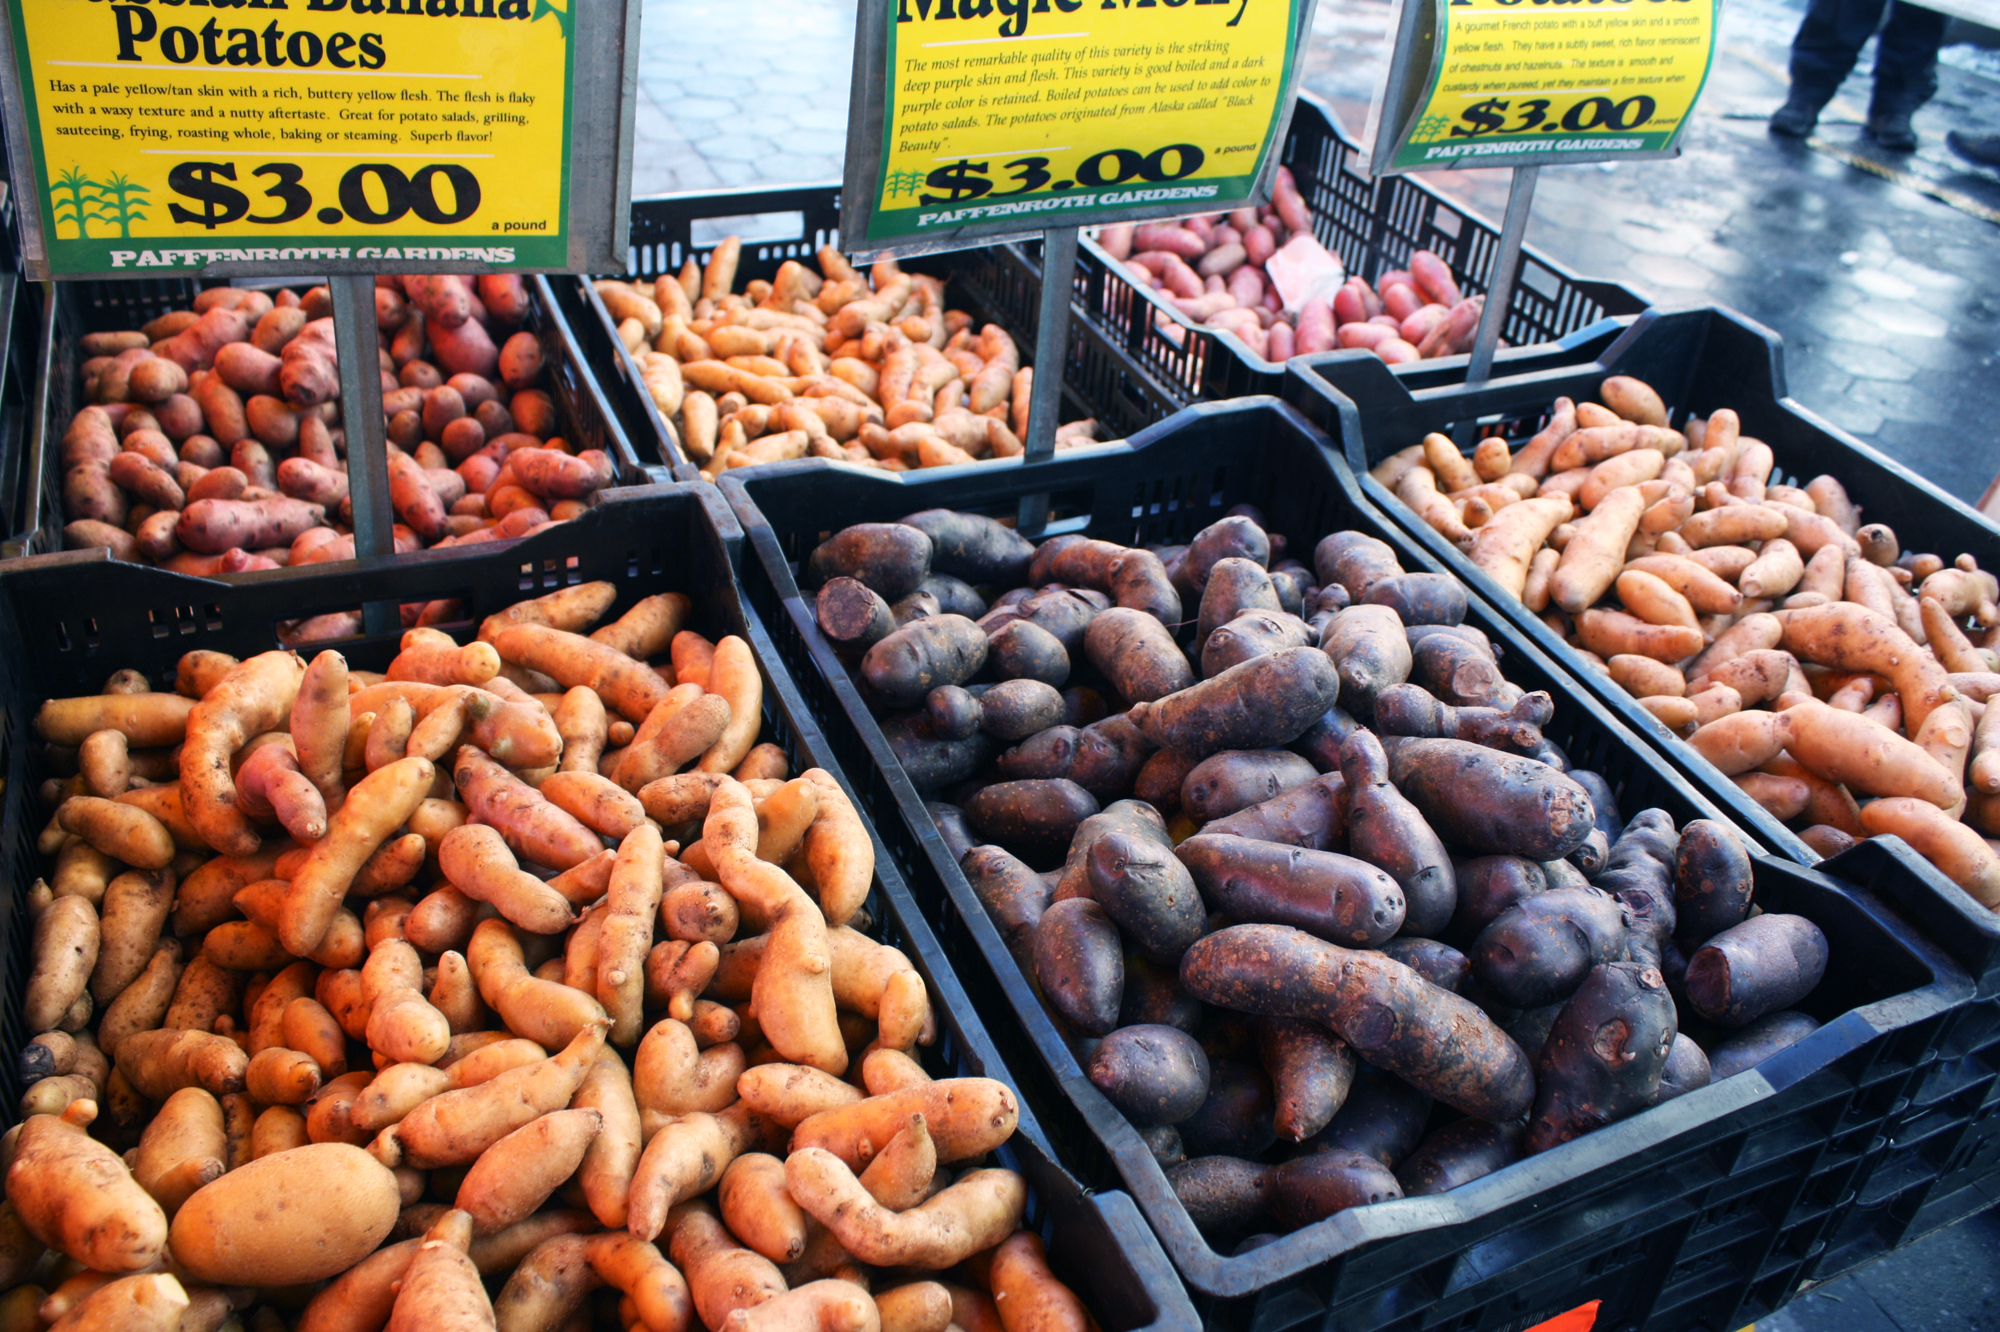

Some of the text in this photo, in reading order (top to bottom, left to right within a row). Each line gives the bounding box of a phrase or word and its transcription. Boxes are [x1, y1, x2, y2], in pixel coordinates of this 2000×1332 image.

[111, 5, 386, 69] Potatoes
[1465, 22, 1500, 34] gourmet
[1502, 20, 1531, 31] French
[1533, 19, 1559, 32] potato
[1562, 19, 1577, 29] with
[1587, 18, 1603, 28] buff
[1605, 18, 1629, 31] yellow
[1632, 17, 1647, 26] skin
[1649, 16, 1665, 26] and
[1673, 15, 1700, 26] smooth
[905, 40, 1230, 72] The most remarkable quality of this variety is the striking
[1453, 42, 1481, 55] yellow
[1483, 41, 1505, 52] flesh.
[1513, 40, 1532, 53] They
[1535, 40, 1555, 51] have
[1565, 39, 1589, 51] subtly
[1591, 39, 1616, 49] sweet,
[1619, 37, 1633, 47] rich
[1635, 36, 1656, 46] flavor
[1658, 36, 1701, 47] reminiscent
[904, 56, 1265, 94] deep purple skin and flesh. This variety is good boiled and a dark
[1460, 62, 1502, 73] chestnuts
[1504, 61, 1522, 71] and
[1523, 60, 1564, 71] hazelnuts.
[1571, 58, 1586, 70] The
[1588, 58, 1616, 68] texture
[1629, 56, 1657, 67] smooth
[1659, 56, 1674, 65] and
[49, 80, 75, 92] Has
[93, 83, 119, 96] pale
[125, 84, 192, 98] yellow/tan
[198, 85, 223, 96] skin
[229, 86, 257, 97] with
[274, 87, 302, 99] rich,
[307, 87, 352, 102] buttery
[357, 90, 396, 103] yellow
[401, 89, 432, 100] flesh.
[436, 90, 459, 101] The
[465, 91, 490, 102] flesh
[496, 93, 504, 102] is
[509, 92, 535, 106] flaky
[902, 76, 1271, 116] purple color is retained. Boiled potatoes can be used to add color to
[53, 102, 84, 114] with
[101, 107, 133, 119] waxy
[139, 107, 185, 116] texture
[191, 106, 213, 117] and
[230, 109, 263, 121] nutty
[269, 107, 329, 119] aftertaste.
[339, 109, 372, 120] Great
[378, 109, 394, 120] for
[400, 113, 437, 124] potato
[442, 111, 479, 122] salads,
[483, 113, 529, 125] grilling,
[900, 94, 1254, 136] potato salads. The potatoes originated from Alaska called "Black
[1450, 95, 1656, 138] $3.00
[56, 126, 124, 140] sauteeing,
[130, 125, 172, 140] frying,
[178, 128, 229, 141] roasting
[233, 127, 275, 140] whole,
[280, 128, 322, 143] baking
[344, 131, 401, 143] steaming.
[411, 130, 452, 144] Superb
[457, 130, 492, 141] flavor!
[1223, 143, 1257, 155] pound
[1424, 138, 1646, 160] PAFFENROTH GARDENS
[919, 143, 1205, 207] $3.00
[168, 162, 481, 229] $3.00
[916, 186, 1218, 226] PAFFENROTH GARDENS
[492, 220, 546, 232] a pound
[110, 247, 515, 266] PAFFENROTH GARDENS
